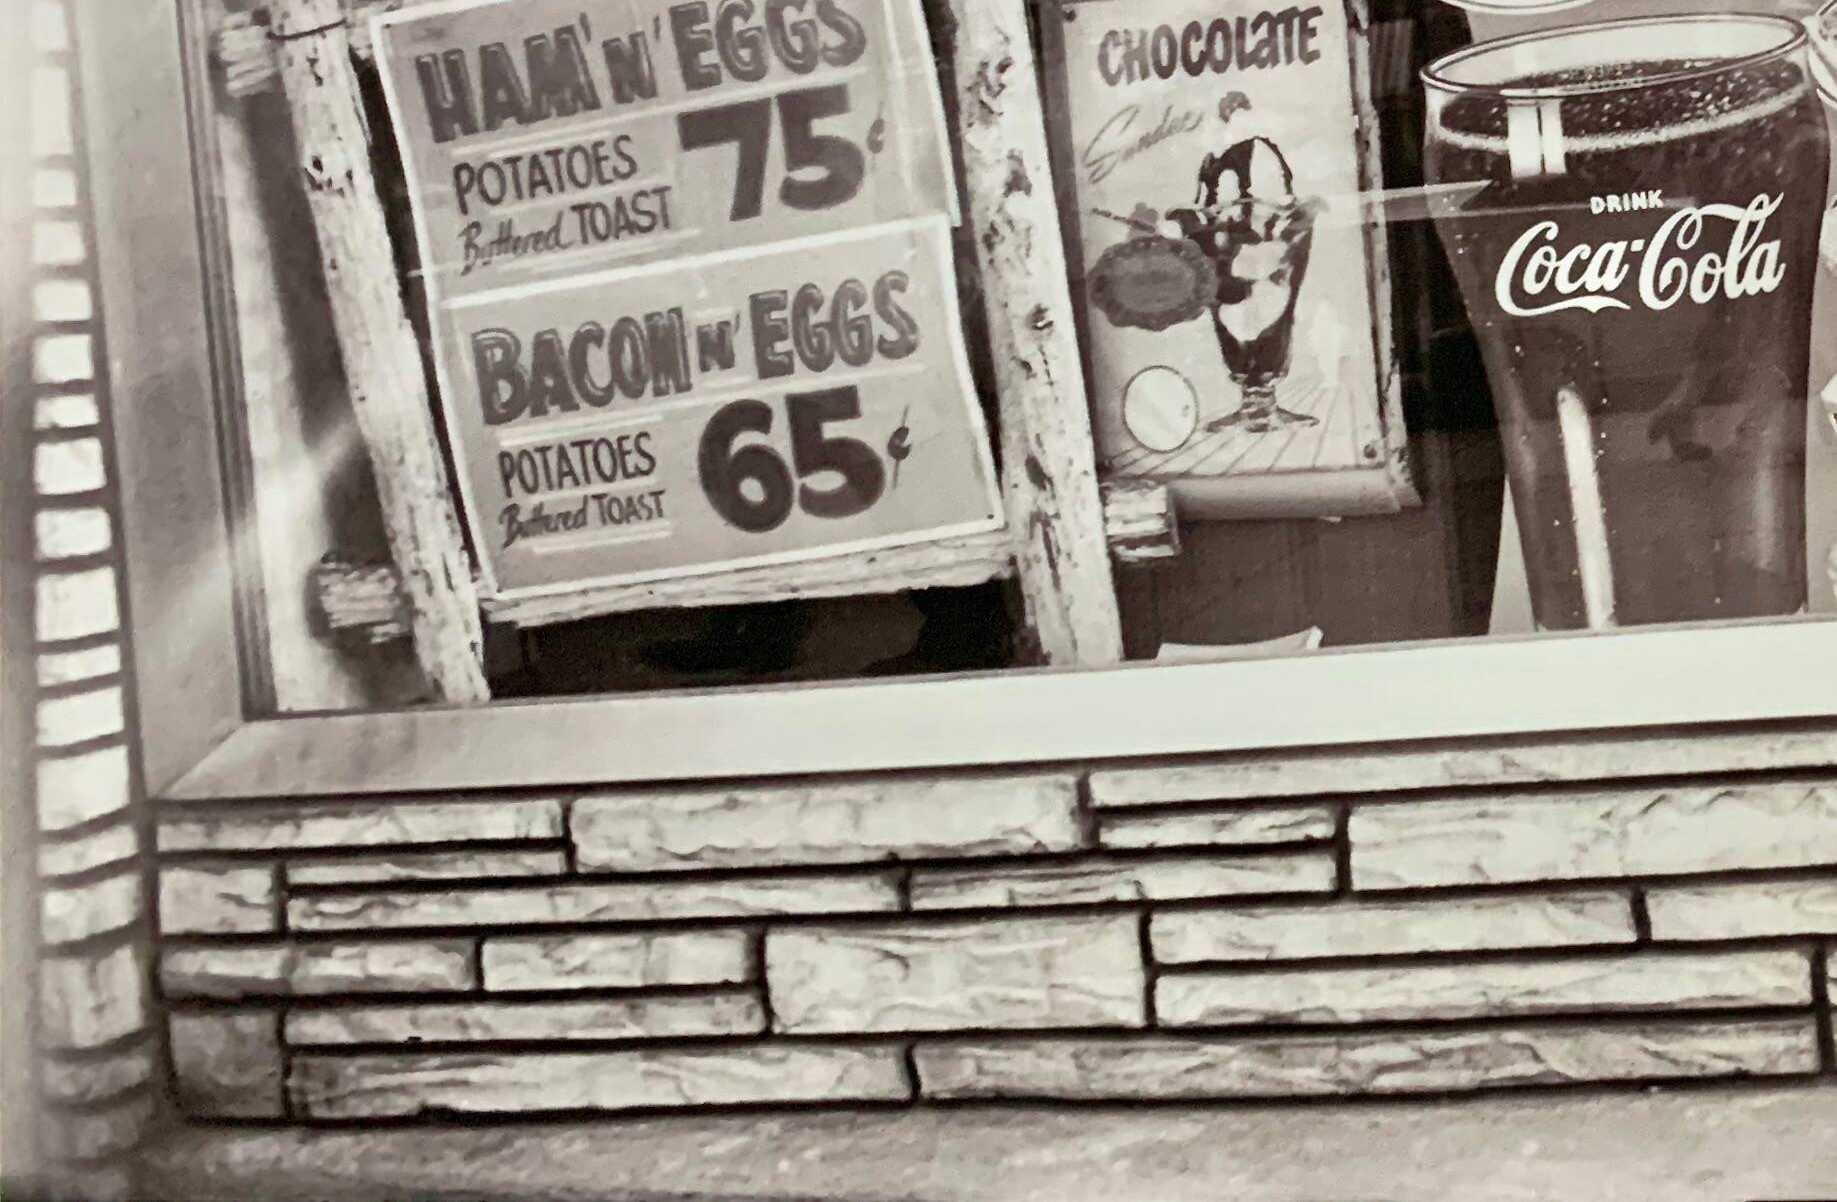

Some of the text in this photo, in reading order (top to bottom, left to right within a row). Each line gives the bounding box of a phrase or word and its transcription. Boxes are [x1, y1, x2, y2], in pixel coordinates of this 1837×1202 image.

[452, 134, 639, 216] POTATOES
[1589, 189, 1665, 215] DRINK
[569, 184, 672, 245] TOAST
[1494, 191, 1787, 317] Coca-Cola
[470, 306, 693, 427] BACON
[748, 269, 920, 380] EGGS
[497, 430, 657, 499] POTATOES
[590, 489, 667, 526] TOAST
